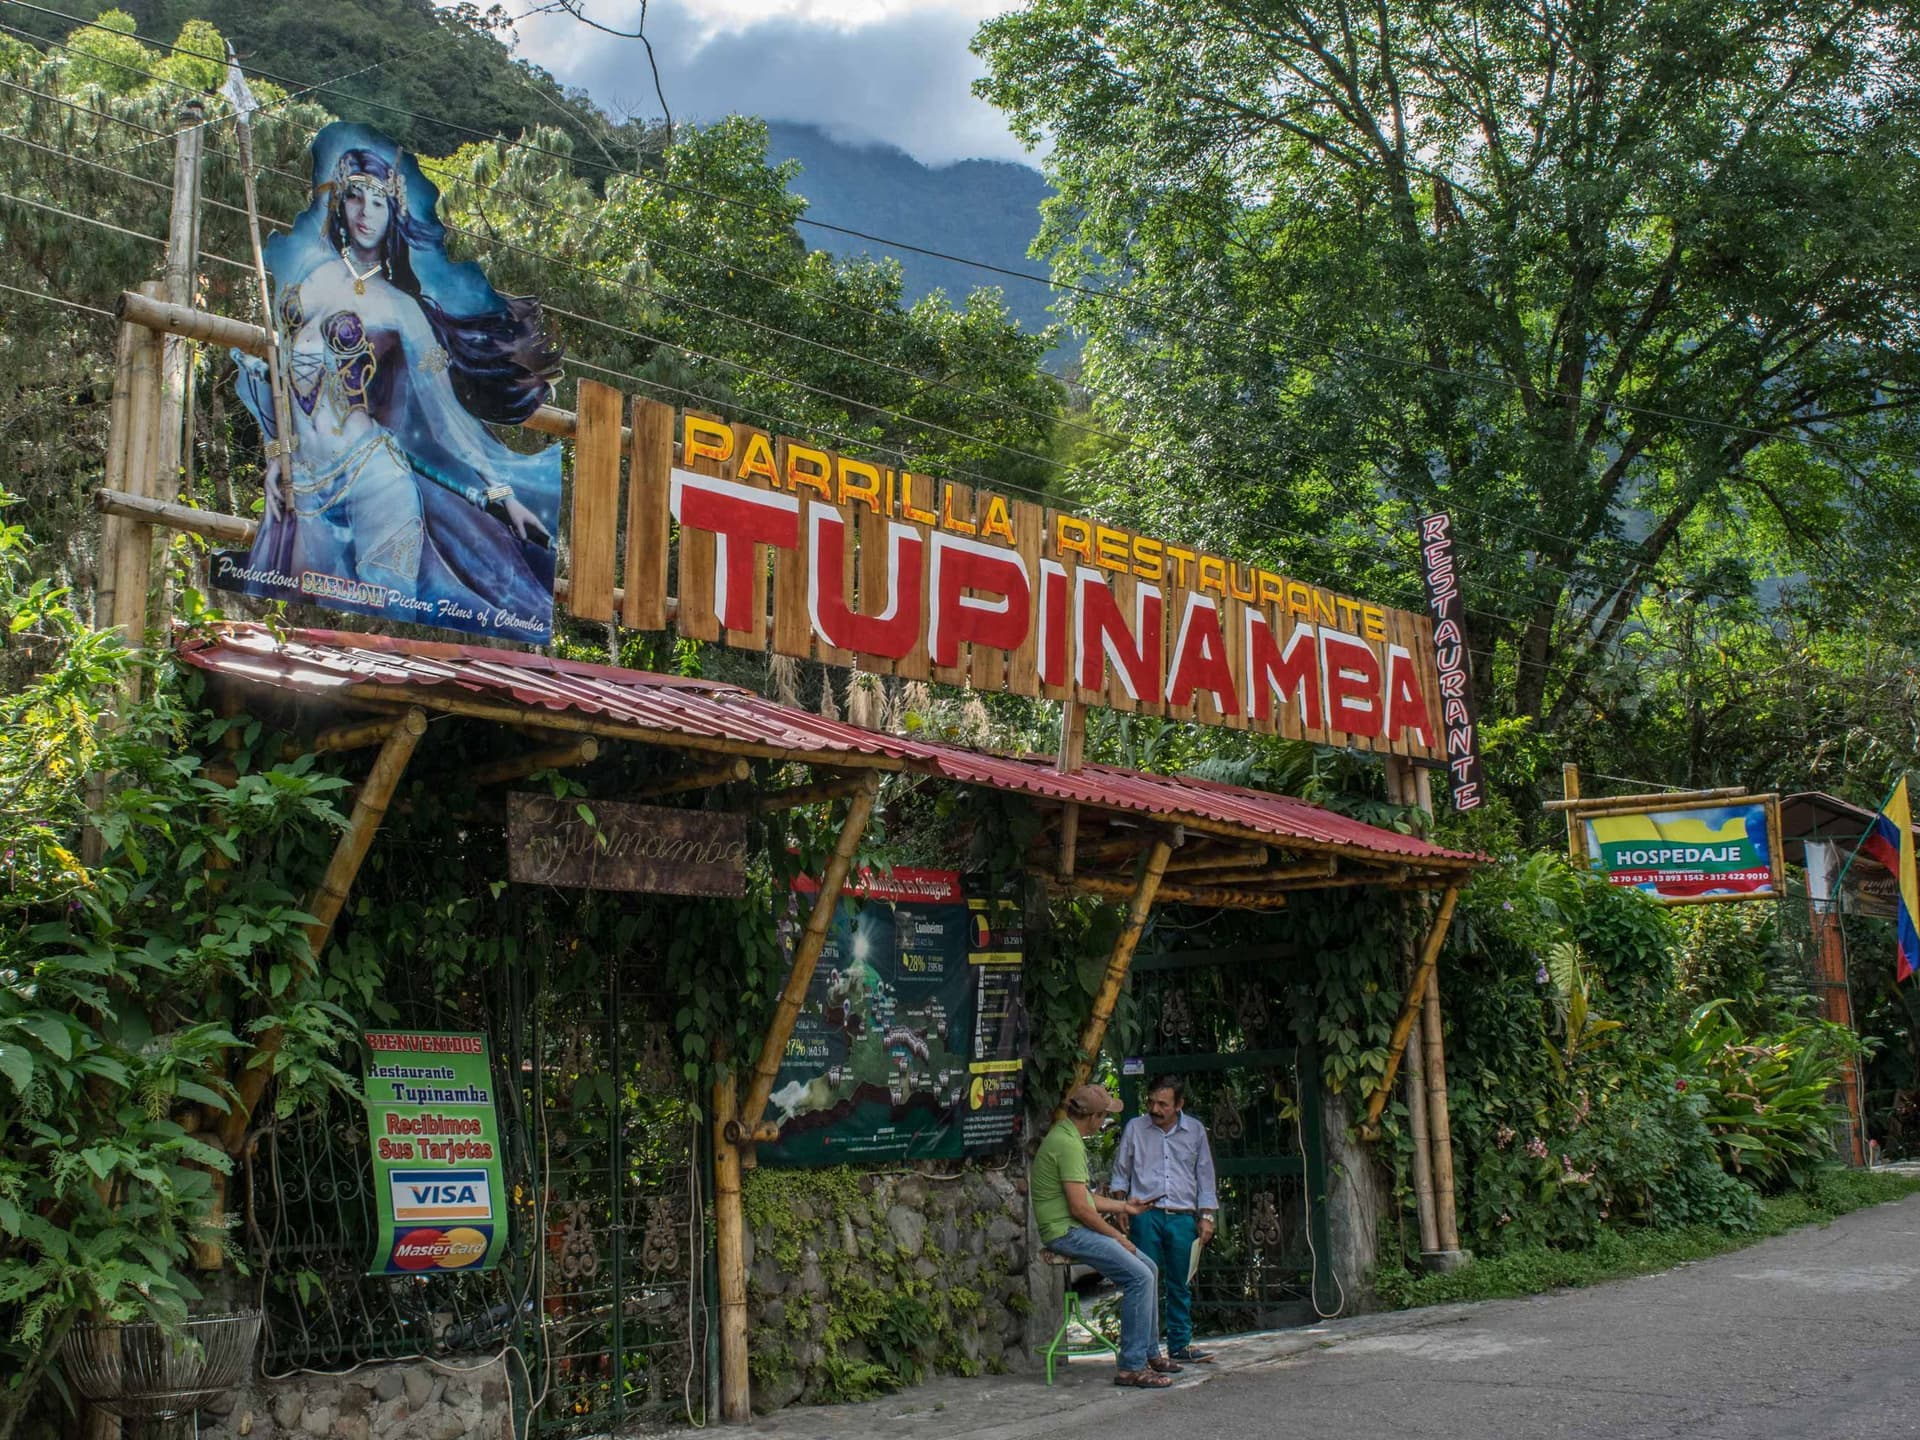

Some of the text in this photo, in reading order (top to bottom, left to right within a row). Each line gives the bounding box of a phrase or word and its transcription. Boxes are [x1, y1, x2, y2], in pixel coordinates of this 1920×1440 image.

[684, 414, 1387, 641] PARRILLA RESTAURANTE
[217, 556, 300, 589] Productions
[388, 590, 434, 613] Picture
[437, 599, 473, 620] Films
[477, 608, 490, 627] of
[493, 609, 546, 633] Colombia
[670, 467, 1436, 748] TUPINAMBA
[1422, 513, 1481, 813] RESTAURANTE
[1616, 847, 1741, 865] HOSPEDAJE
[902, 879, 918, 894] en
[908, 955, 926, 972] 28%
[365, 1033, 483, 1054] BIENVENIDOS
[368, 1063, 455, 1080] Restaurante
[391, 1083, 489, 1105] Tupinamba
[386, 1113, 482, 1136] Recibimos
[378, 1138, 493, 1164] Sus Tarjetas
[409, 1185, 477, 1204] VISA
[395, 1240, 487, 1258] MasterCard
